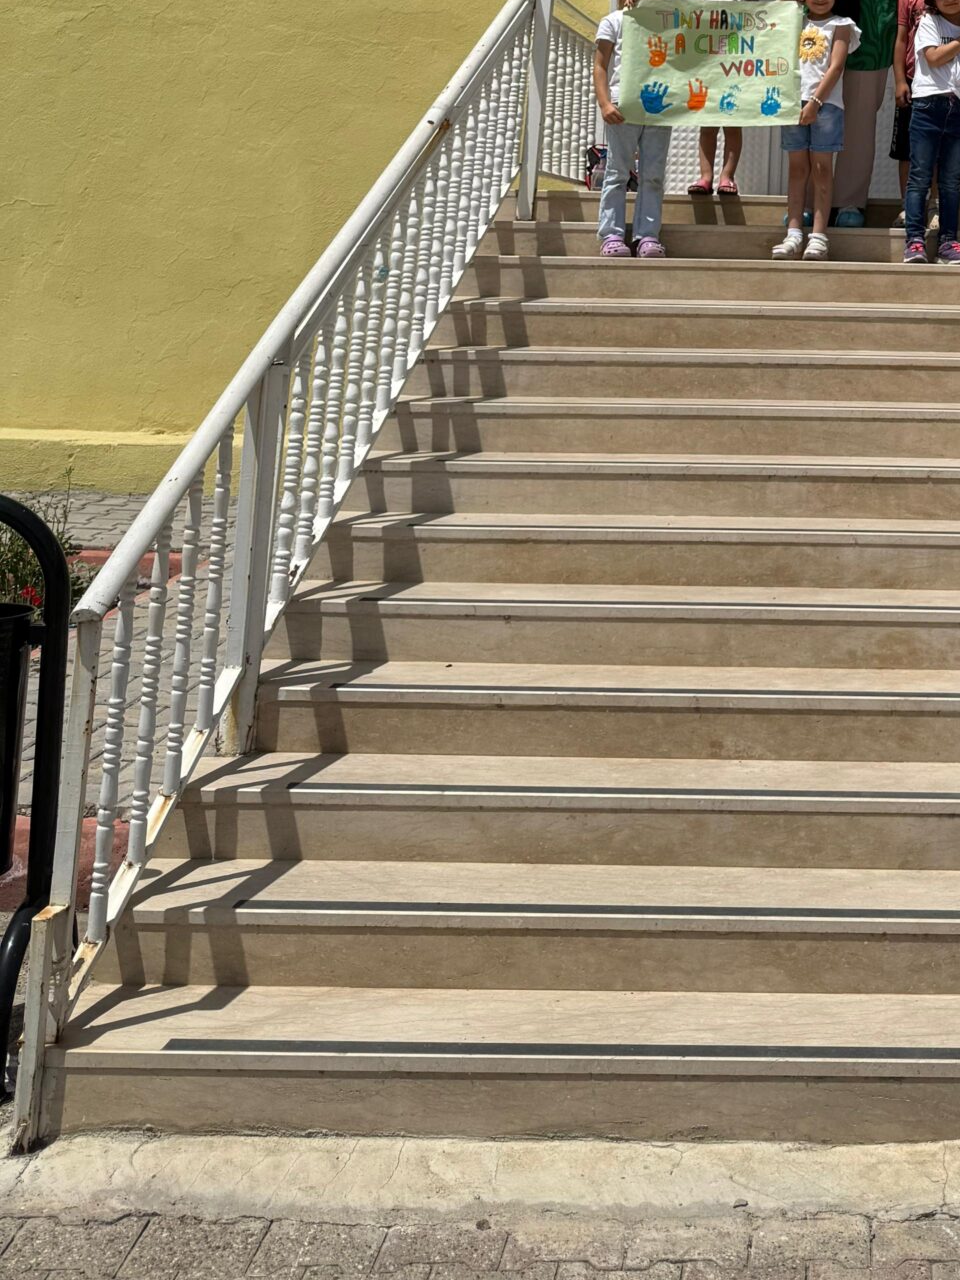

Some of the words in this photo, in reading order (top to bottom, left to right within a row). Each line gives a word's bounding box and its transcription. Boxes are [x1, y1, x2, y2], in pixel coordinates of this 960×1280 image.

[675, 33, 686, 54] A
[694, 32, 755, 55] CLEAN
[720, 57, 789, 77] WORLD
